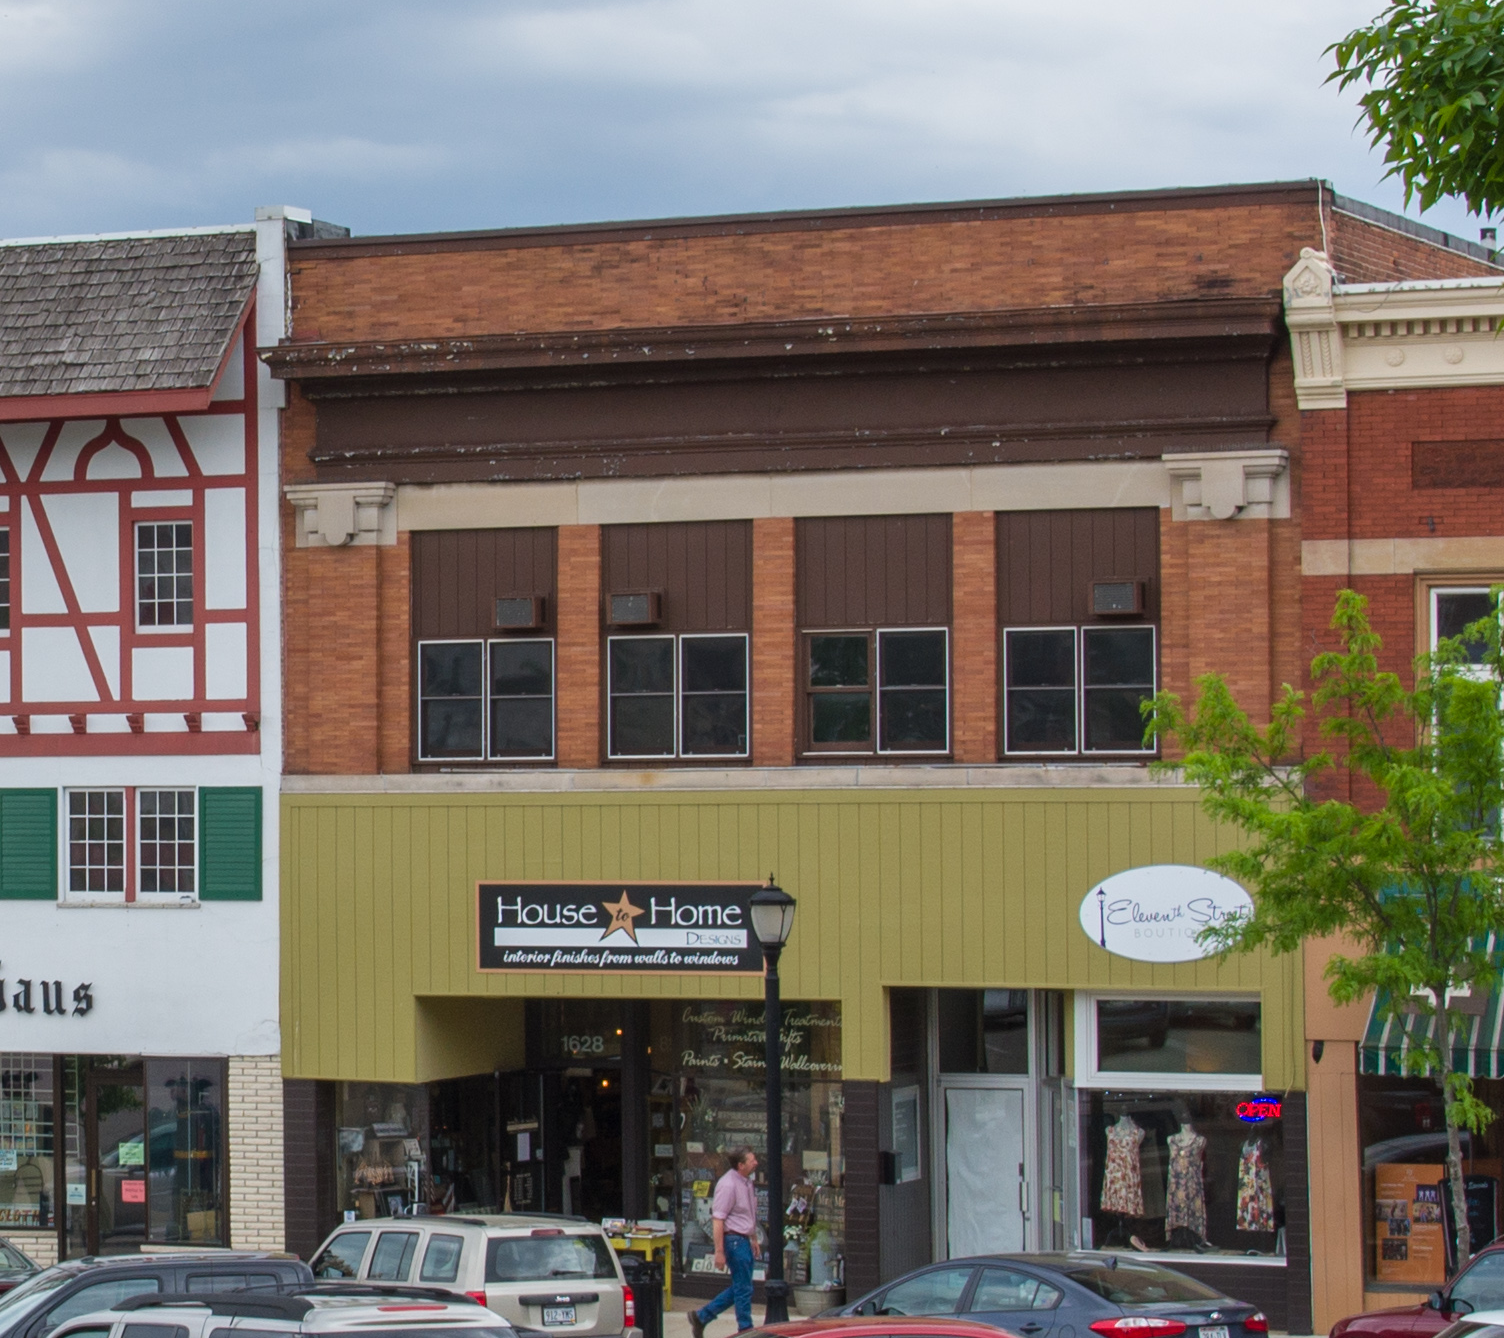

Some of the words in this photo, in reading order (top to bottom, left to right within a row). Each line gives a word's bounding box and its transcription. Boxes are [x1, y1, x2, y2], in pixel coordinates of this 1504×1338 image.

[497, 896, 598, 924] House
[615, 907, 629, 922] to
[650, 897, 742, 925] Home
[1106, 899, 1184, 925] Eleventh
[686, 932, 741, 945] DESIGNS
[503, 949, 550, 963] interior
[550, 949, 600, 966] finishes
[599, 950, 634, 966] from
[634, 949, 669, 964] walls
[669, 951, 682, 964] to
[683, 951, 739, 965] windows
[682, 1007, 724, 1024] Custom
[730, 1008, 766, 1025] Wind
[561, 1035, 604, 1053] 1628
[708, 1027, 766, 1043] Primitiv
[780, 1028, 804, 1052] ifts
[681, 1050, 722, 1067] Paints
[732, 1051, 767, 1069] Stain
[780, 1054, 842, 1072] Wallcoverin
[1235, 1102, 1282, 1117] OPEN
